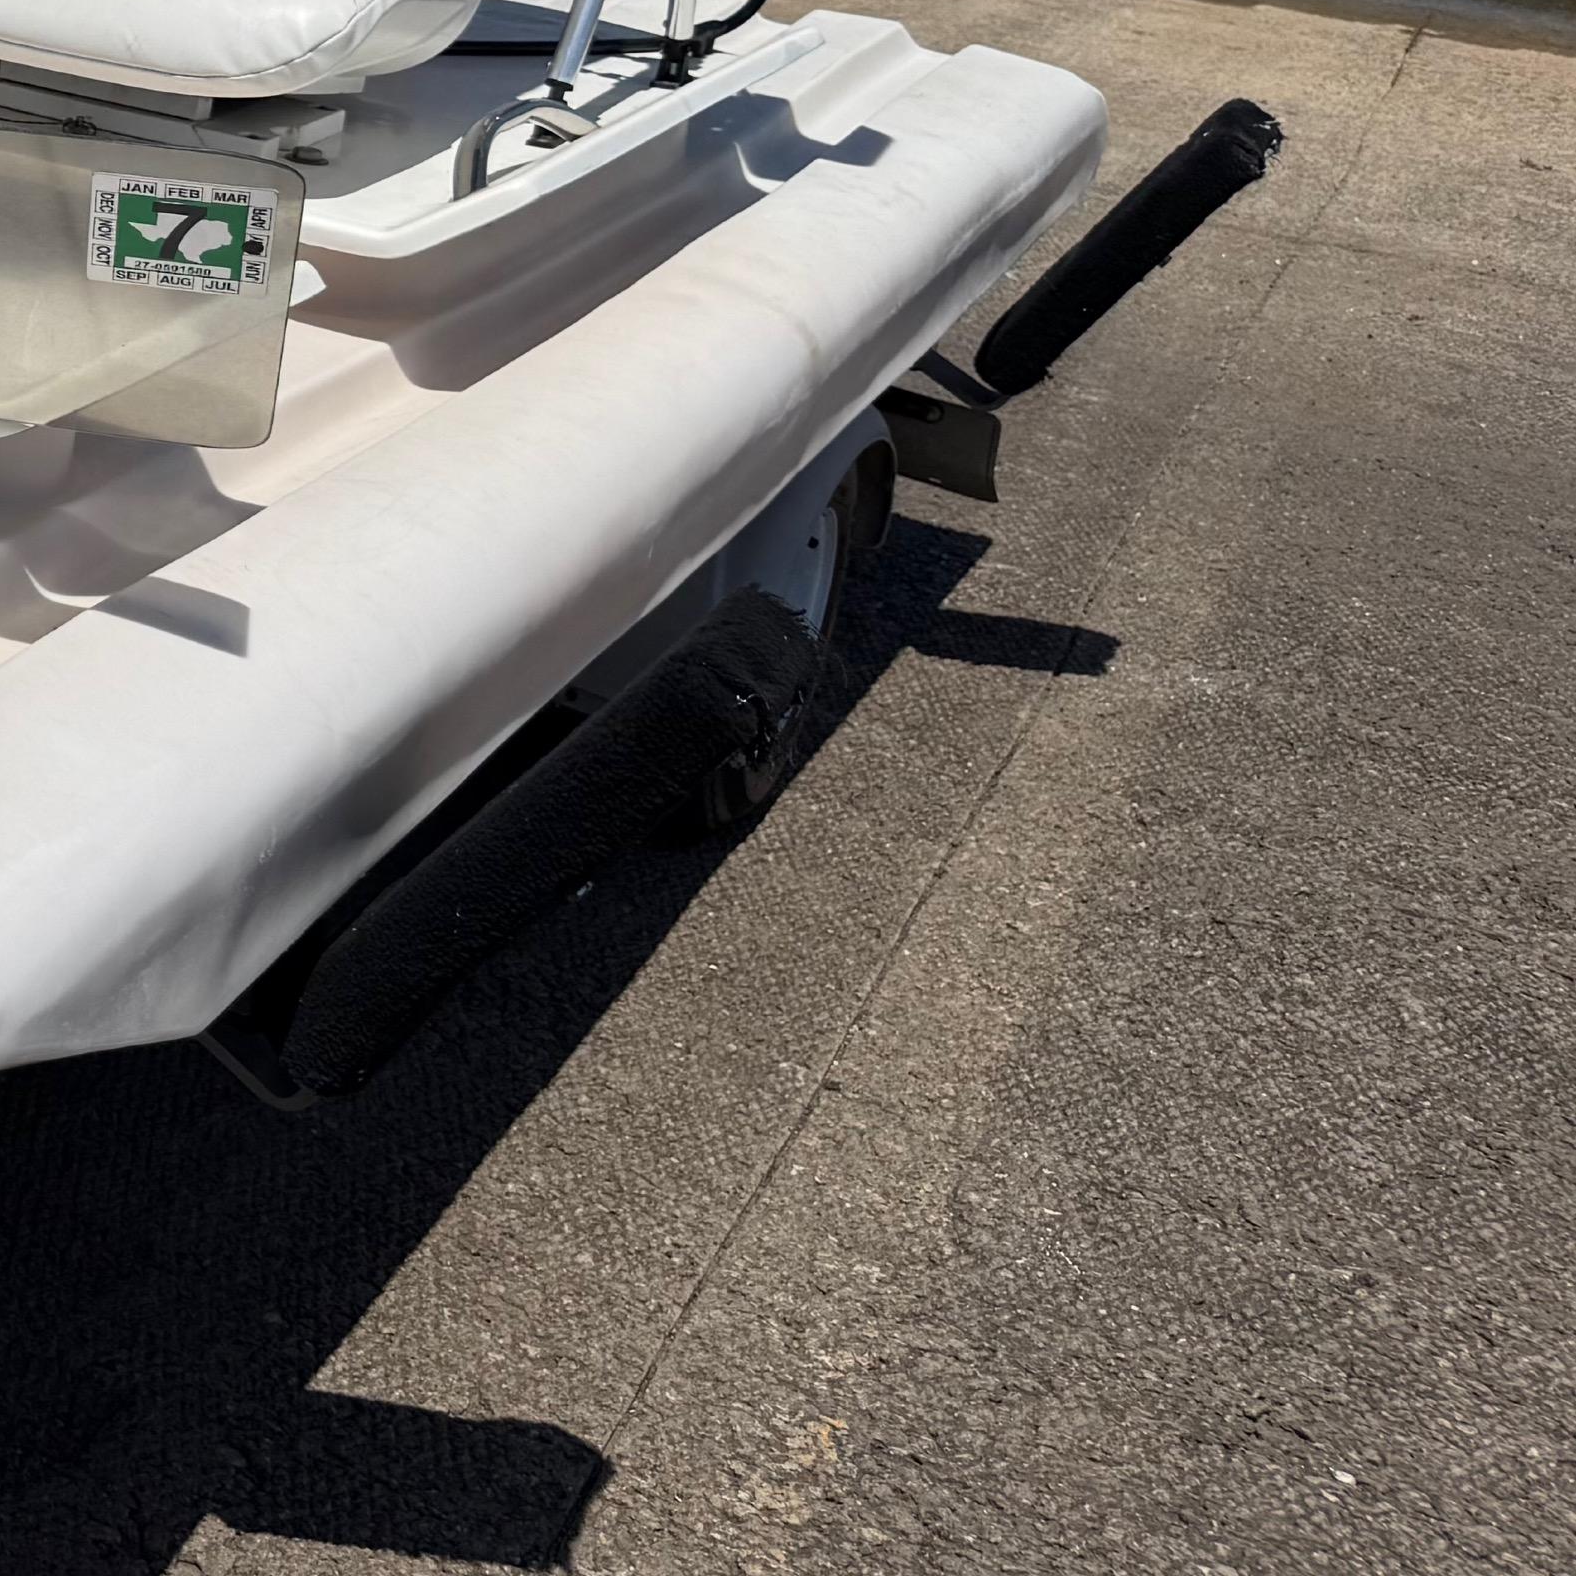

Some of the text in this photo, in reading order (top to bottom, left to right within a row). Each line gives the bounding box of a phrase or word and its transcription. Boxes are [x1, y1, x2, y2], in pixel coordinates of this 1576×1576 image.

[99, 192, 115, 214] DEC
[121, 181, 248, 204] JAN FEB MAR
[98, 218, 113, 240] NOV
[250, 207, 268, 229] APR
[151, 201, 208, 261] 7
[96, 245, 112, 267] OCT
[115, 269, 237, 292] SEP AUG JUL
[245, 261, 261, 281] JUN
